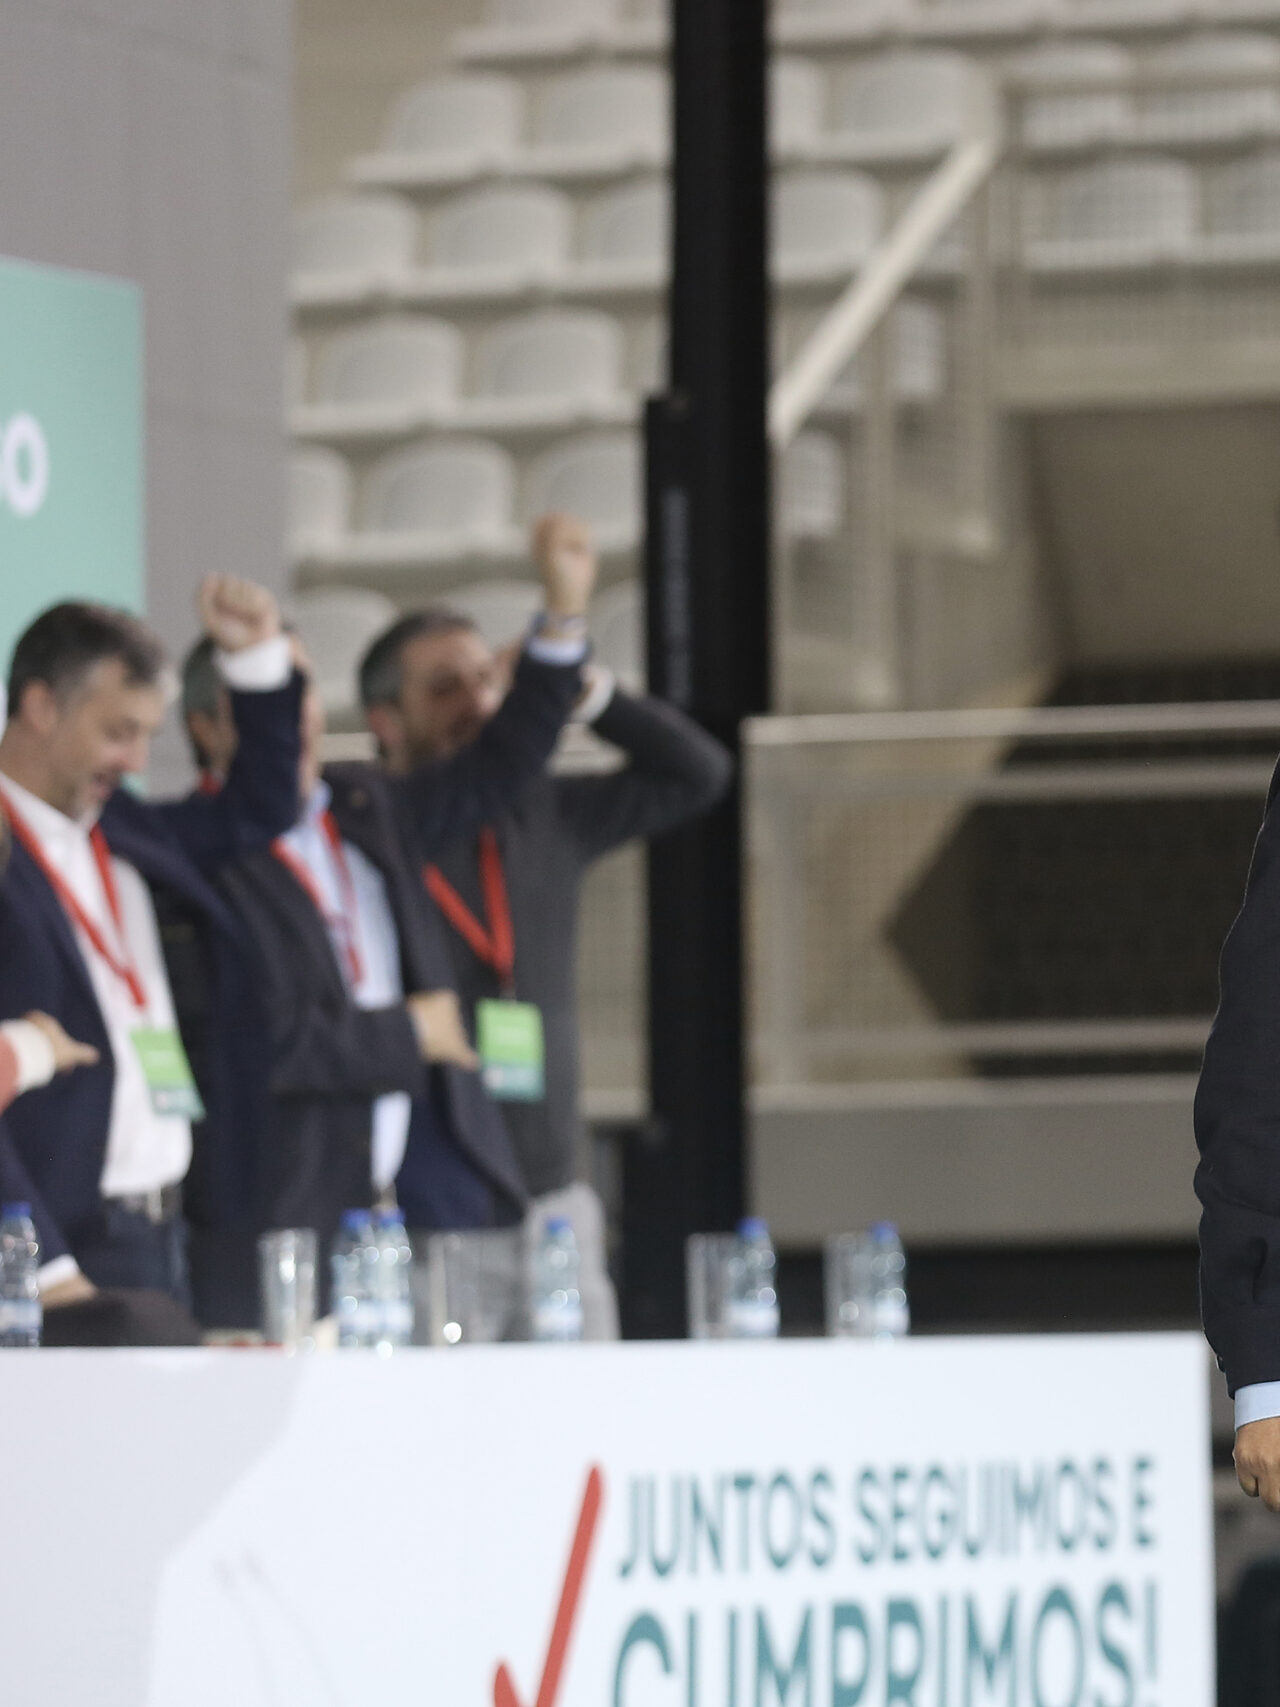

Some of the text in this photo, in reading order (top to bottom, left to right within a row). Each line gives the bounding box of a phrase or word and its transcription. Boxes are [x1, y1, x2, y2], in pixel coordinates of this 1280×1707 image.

[616, 1454, 1156, 1580] JUNTOS SEGUIMOS E
[610, 1576, 1159, 1707] CUMPRIMOS!
